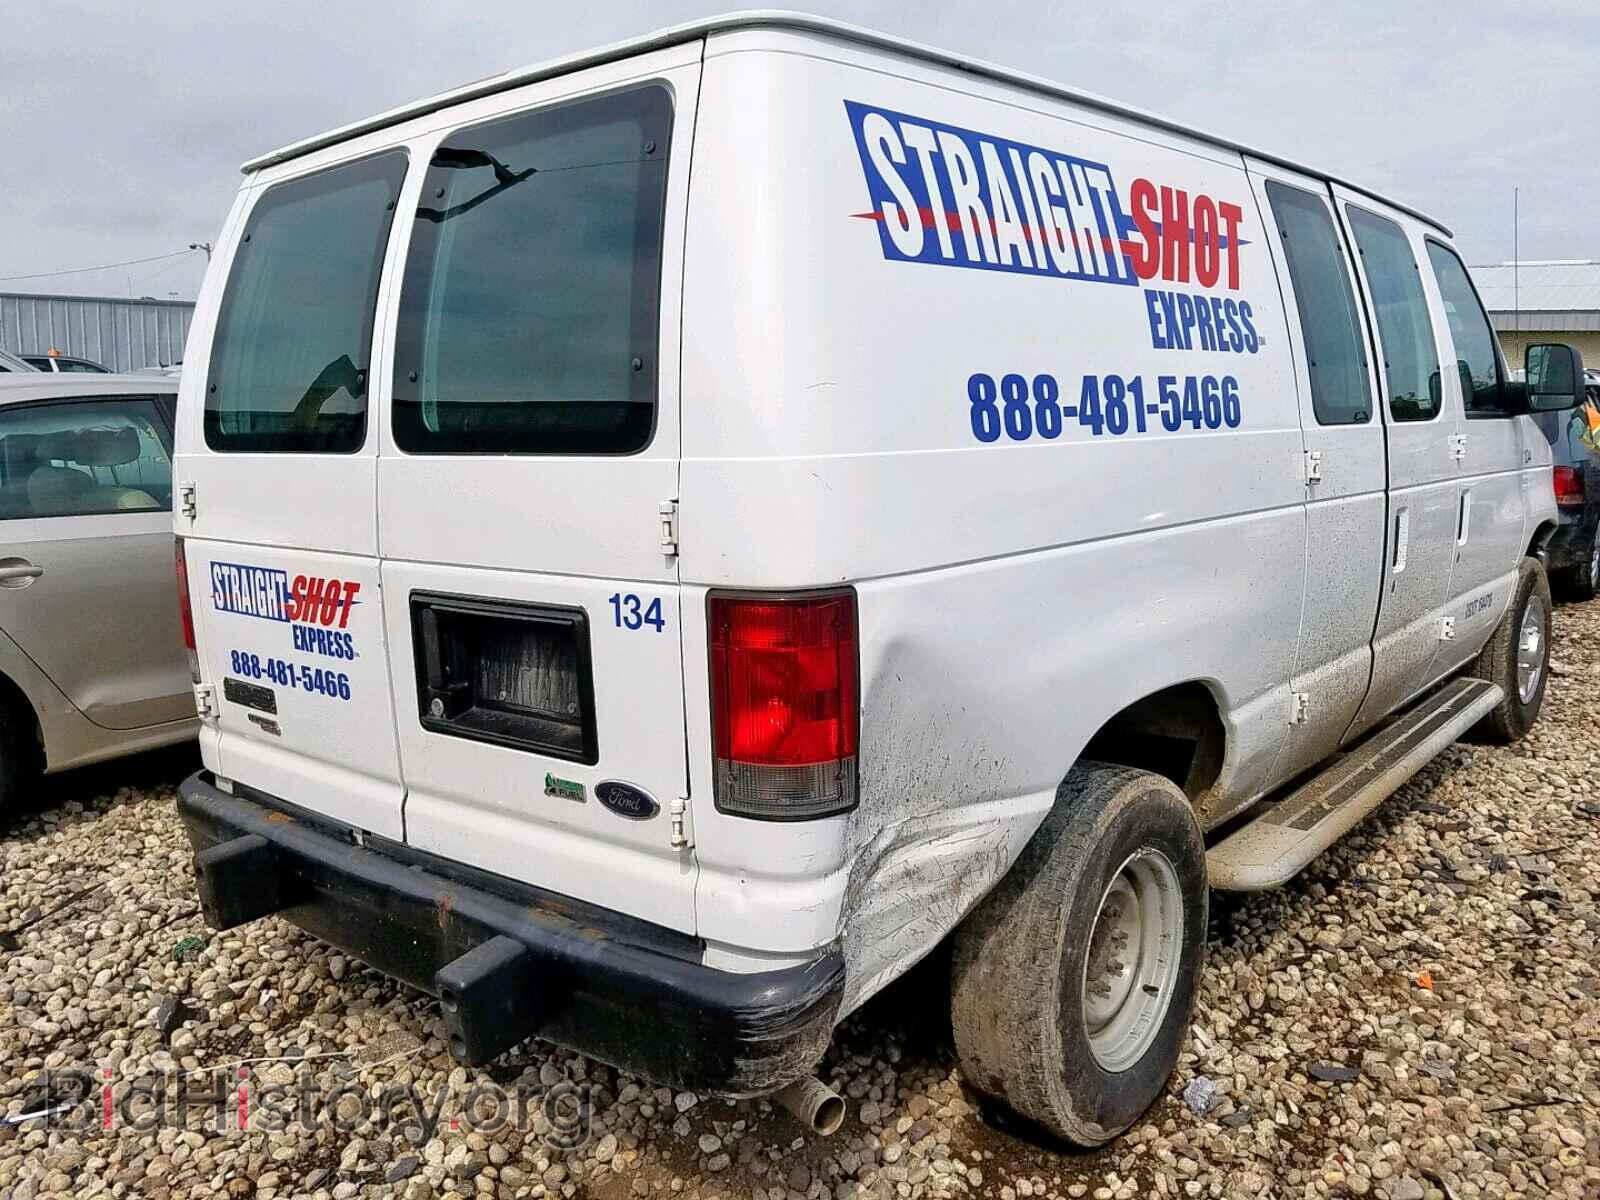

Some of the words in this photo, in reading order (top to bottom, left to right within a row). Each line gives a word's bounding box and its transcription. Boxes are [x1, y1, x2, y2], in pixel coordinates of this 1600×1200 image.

[862, 112, 1128, 281] STRAIGHT
[1130, 178, 1243, 291] SHOT
[1144, 289, 1259, 354] EXPRESS
[967, 373, 1241, 443] 888-481-5466
[212, 564, 287, 621] STRAIGHT
[288, 575, 361, 628] SHOT
[608, 593, 666, 632] 134
[292, 624, 354, 661] EXPRESS
[231, 650, 352, 701] 888-481-5466
[608, 787, 641, 810] Ford
